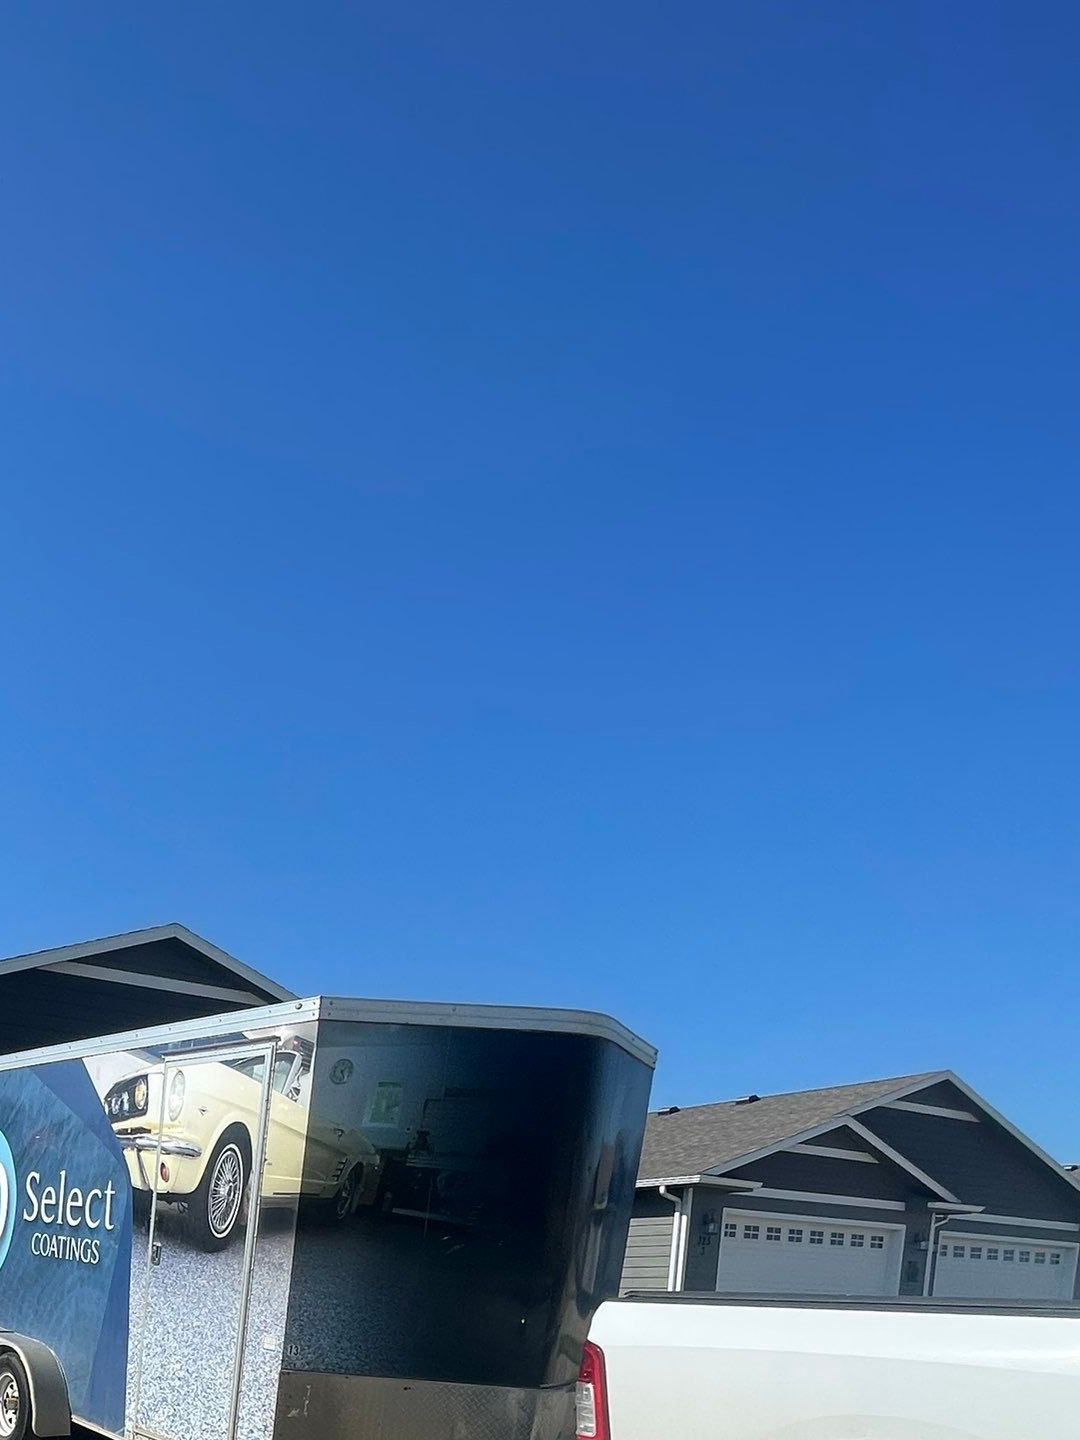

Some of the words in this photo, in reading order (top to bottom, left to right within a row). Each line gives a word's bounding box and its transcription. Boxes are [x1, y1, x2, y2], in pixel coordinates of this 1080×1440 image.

[23, 1169, 116, 1231] Select
[31, 1232, 101, 1265] COATINGS
[289, 1345, 300, 1356] 13
